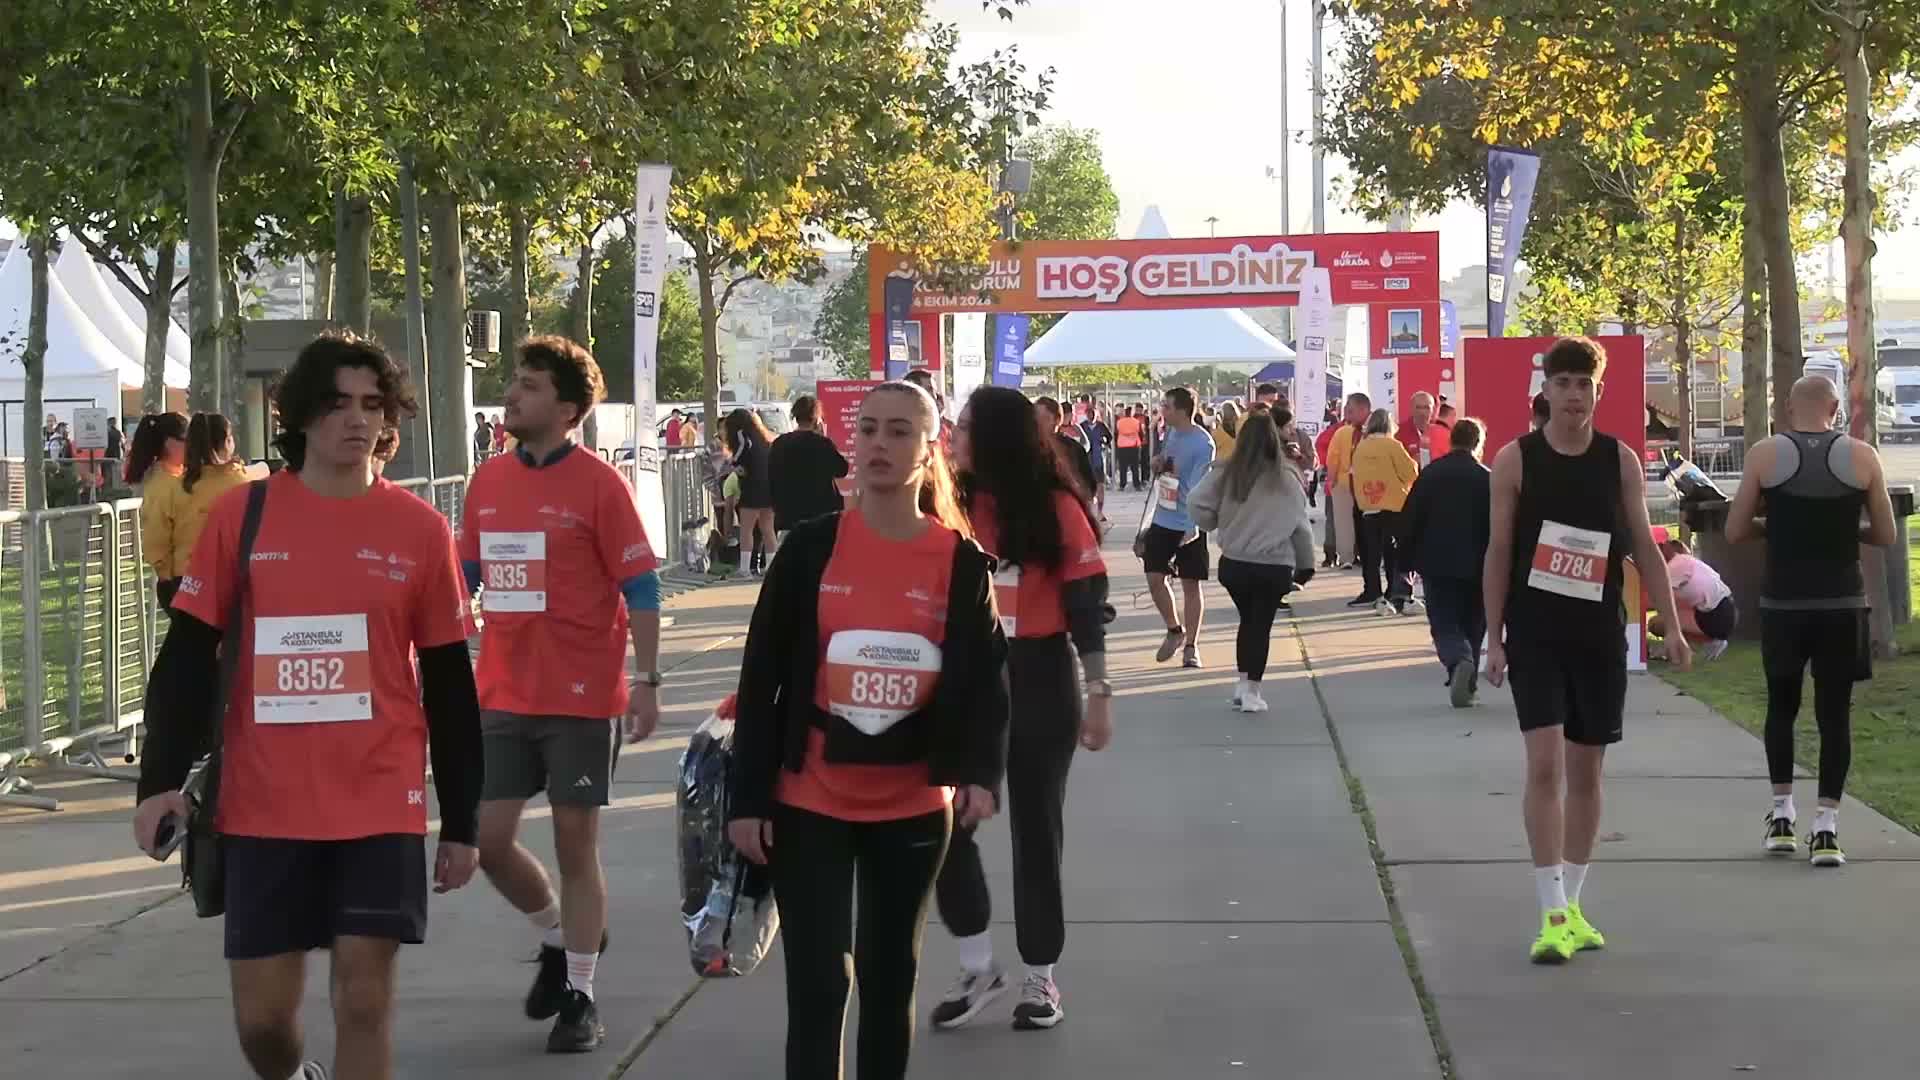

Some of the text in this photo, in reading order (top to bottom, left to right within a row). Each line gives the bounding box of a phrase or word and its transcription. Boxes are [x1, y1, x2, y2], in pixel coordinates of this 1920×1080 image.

[1043, 251, 1308, 295] HOŞ GELDİNİZ
[1550, 551, 1594, 580] 8784
[278, 657, 345, 692] 8352
[851, 671, 919, 706] 8353
